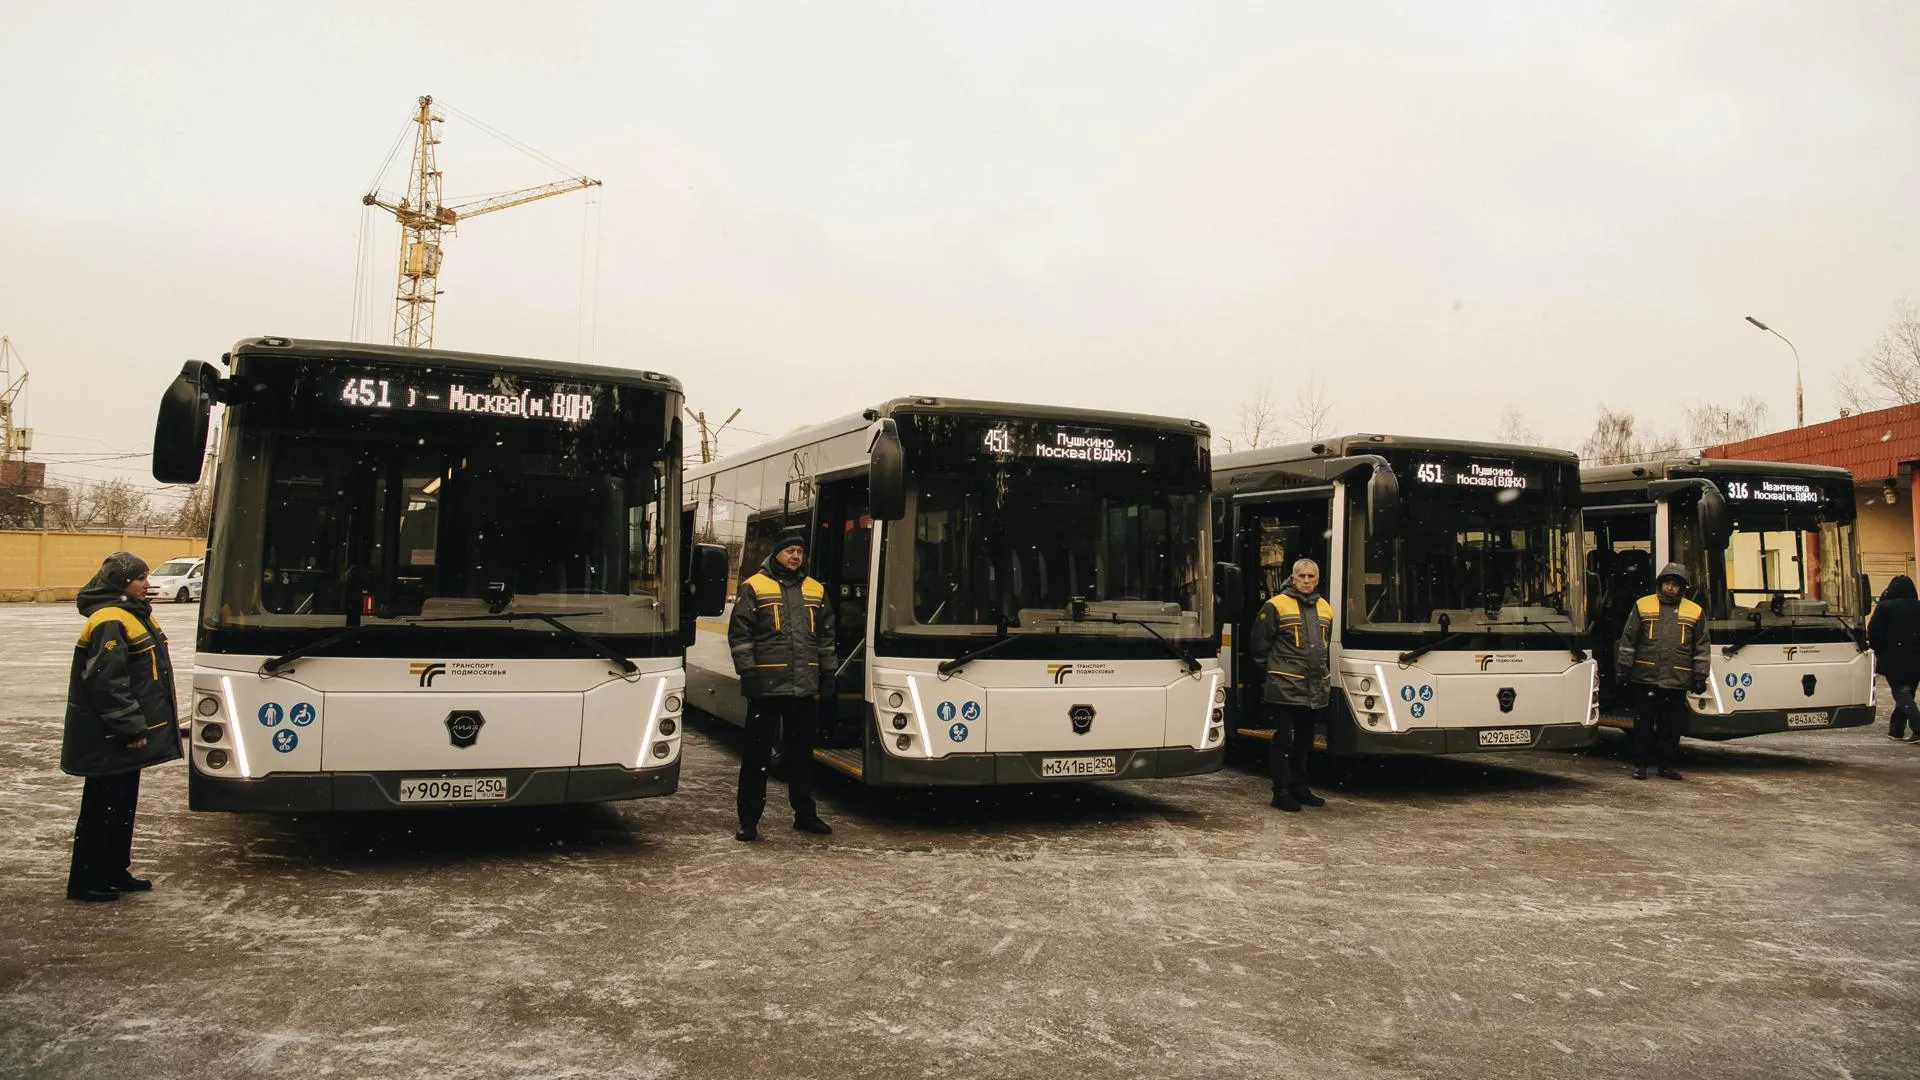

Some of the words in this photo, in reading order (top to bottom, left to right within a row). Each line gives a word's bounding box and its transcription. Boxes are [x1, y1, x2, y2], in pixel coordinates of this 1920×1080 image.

[342, 378, 391, 408] 451
[984, 429, 1010, 453] 451
[1057, 433, 1115, 449] Пушкино
[1417, 463, 1443, 483] 451
[1472, 464, 1514, 477] Пушкино
[1728, 482, 1749, 499] 316
[1763, 481, 1810, 493] Ивантеевка
[1046, 759, 1094, 774] М341ВЕ
[1095, 757, 1113, 769] 250
[407, 782, 473, 799] У909ВЕ
[477, 780, 502, 792] 250
